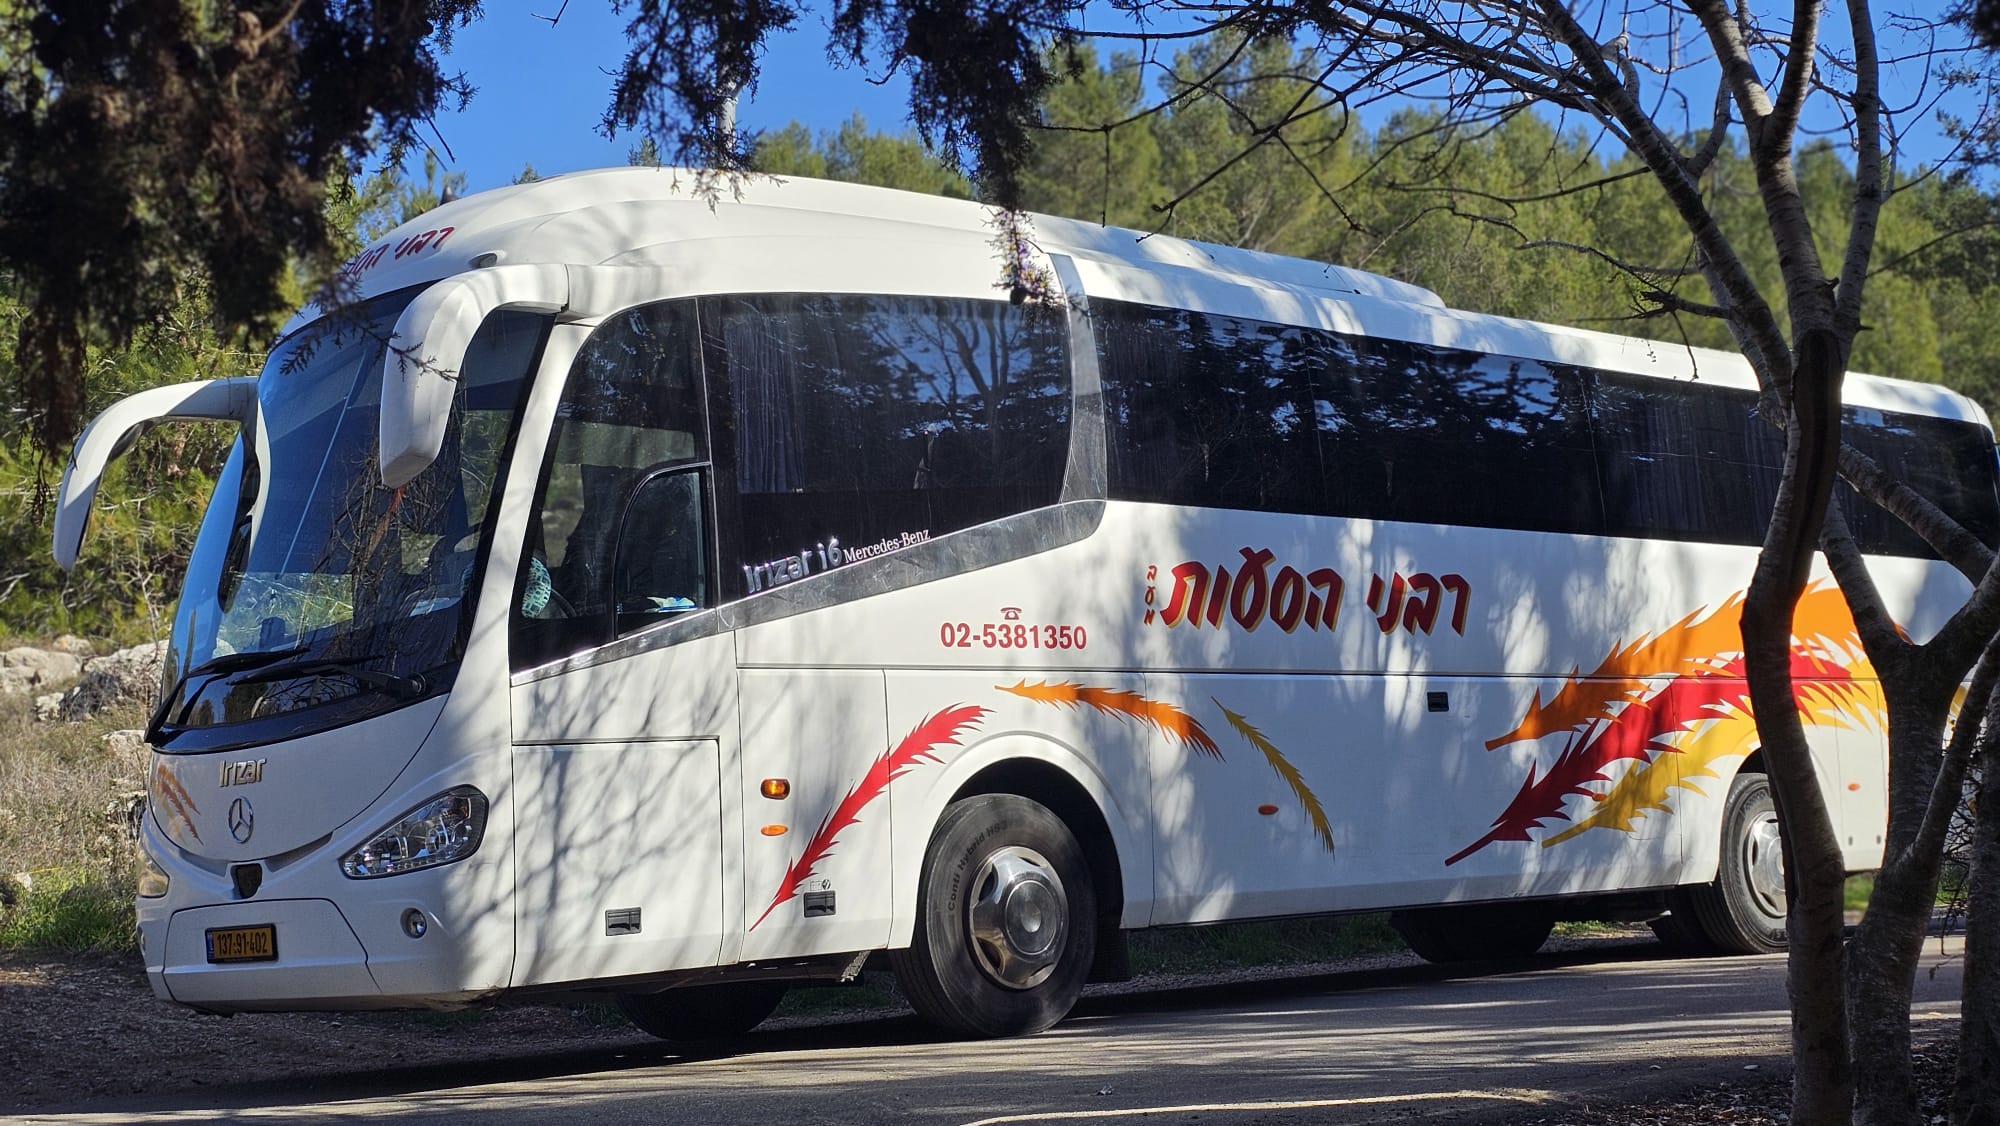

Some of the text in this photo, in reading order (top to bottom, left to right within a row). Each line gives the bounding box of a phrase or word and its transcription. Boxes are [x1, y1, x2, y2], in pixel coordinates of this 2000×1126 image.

[742, 529, 931, 594] Irizar i6 Mercedes-Benz
[1159, 546, 1472, 638] רבני הסעות
[940, 622, 1088, 650] 02-5381350
[219, 758, 268, 788] Irizar
[947, 873, 961, 912] Conti
[957, 832, 986, 871] Hybrid
